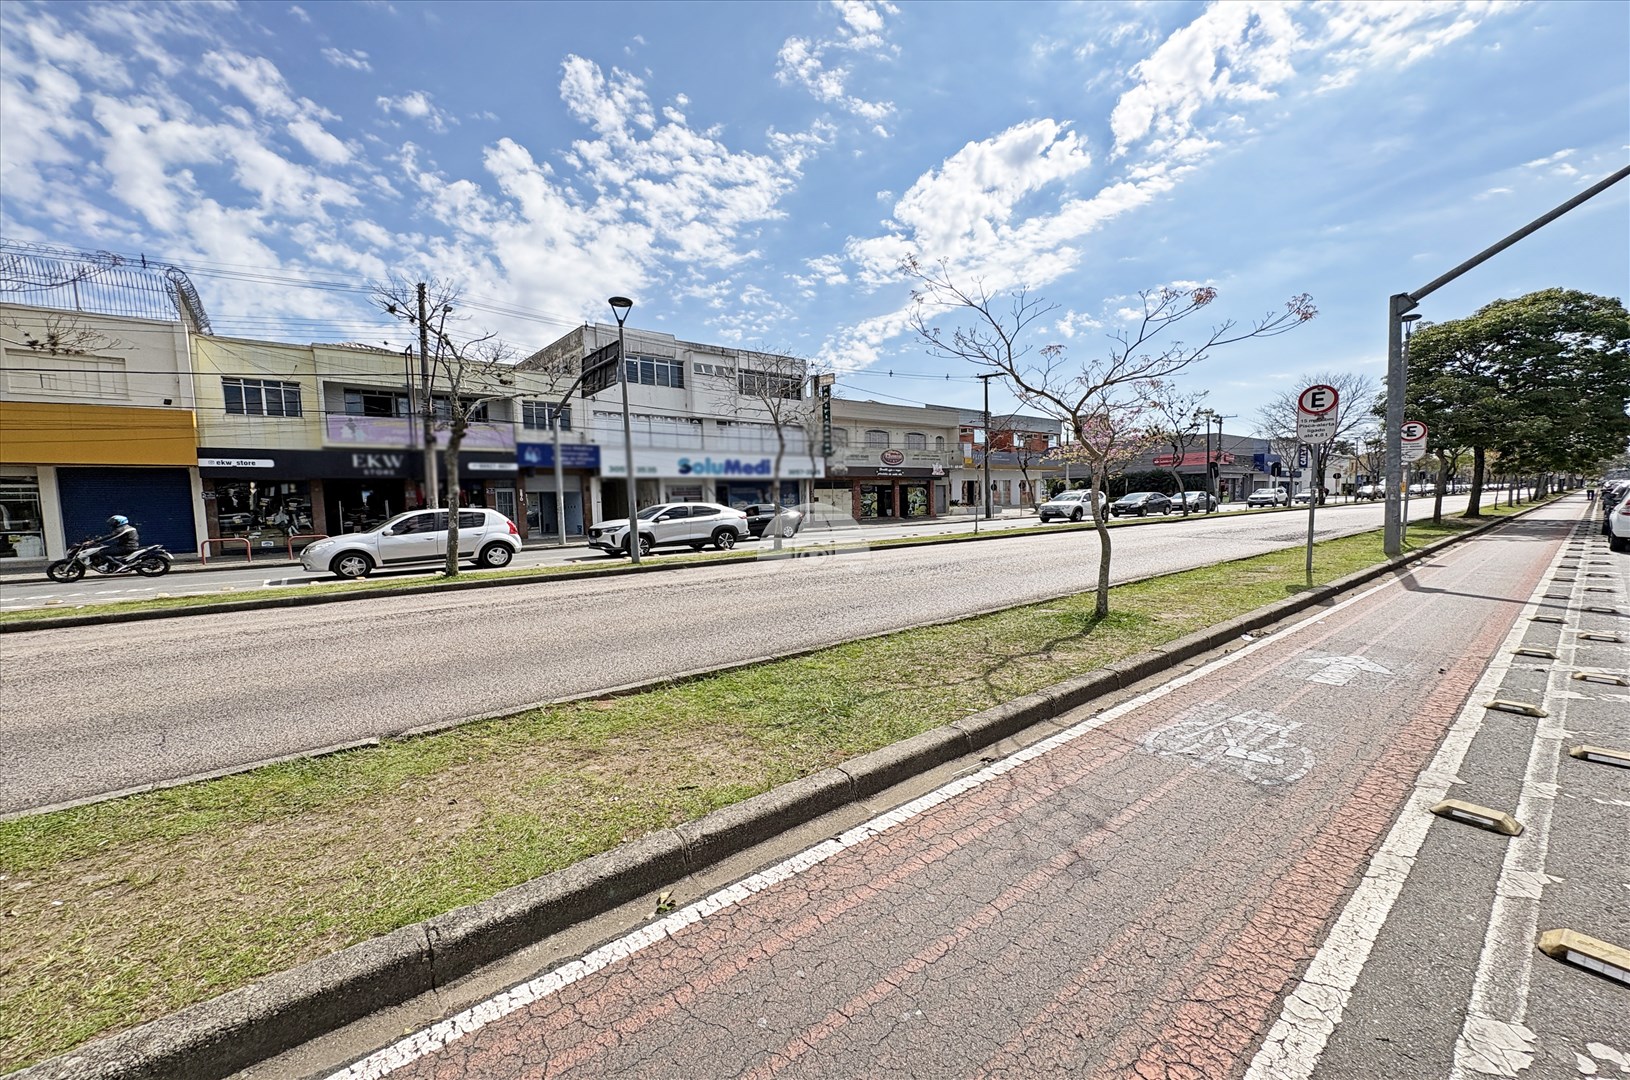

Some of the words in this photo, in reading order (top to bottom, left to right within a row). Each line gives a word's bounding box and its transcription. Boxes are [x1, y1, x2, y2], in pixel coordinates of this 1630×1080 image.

[1310, 391, 1326, 408] E
[1406, 426, 1418, 438] E
[215, 459, 257, 468] ekw_store
[352, 453, 404, 468] EKW
[677, 457, 771, 475] SoluMedi
